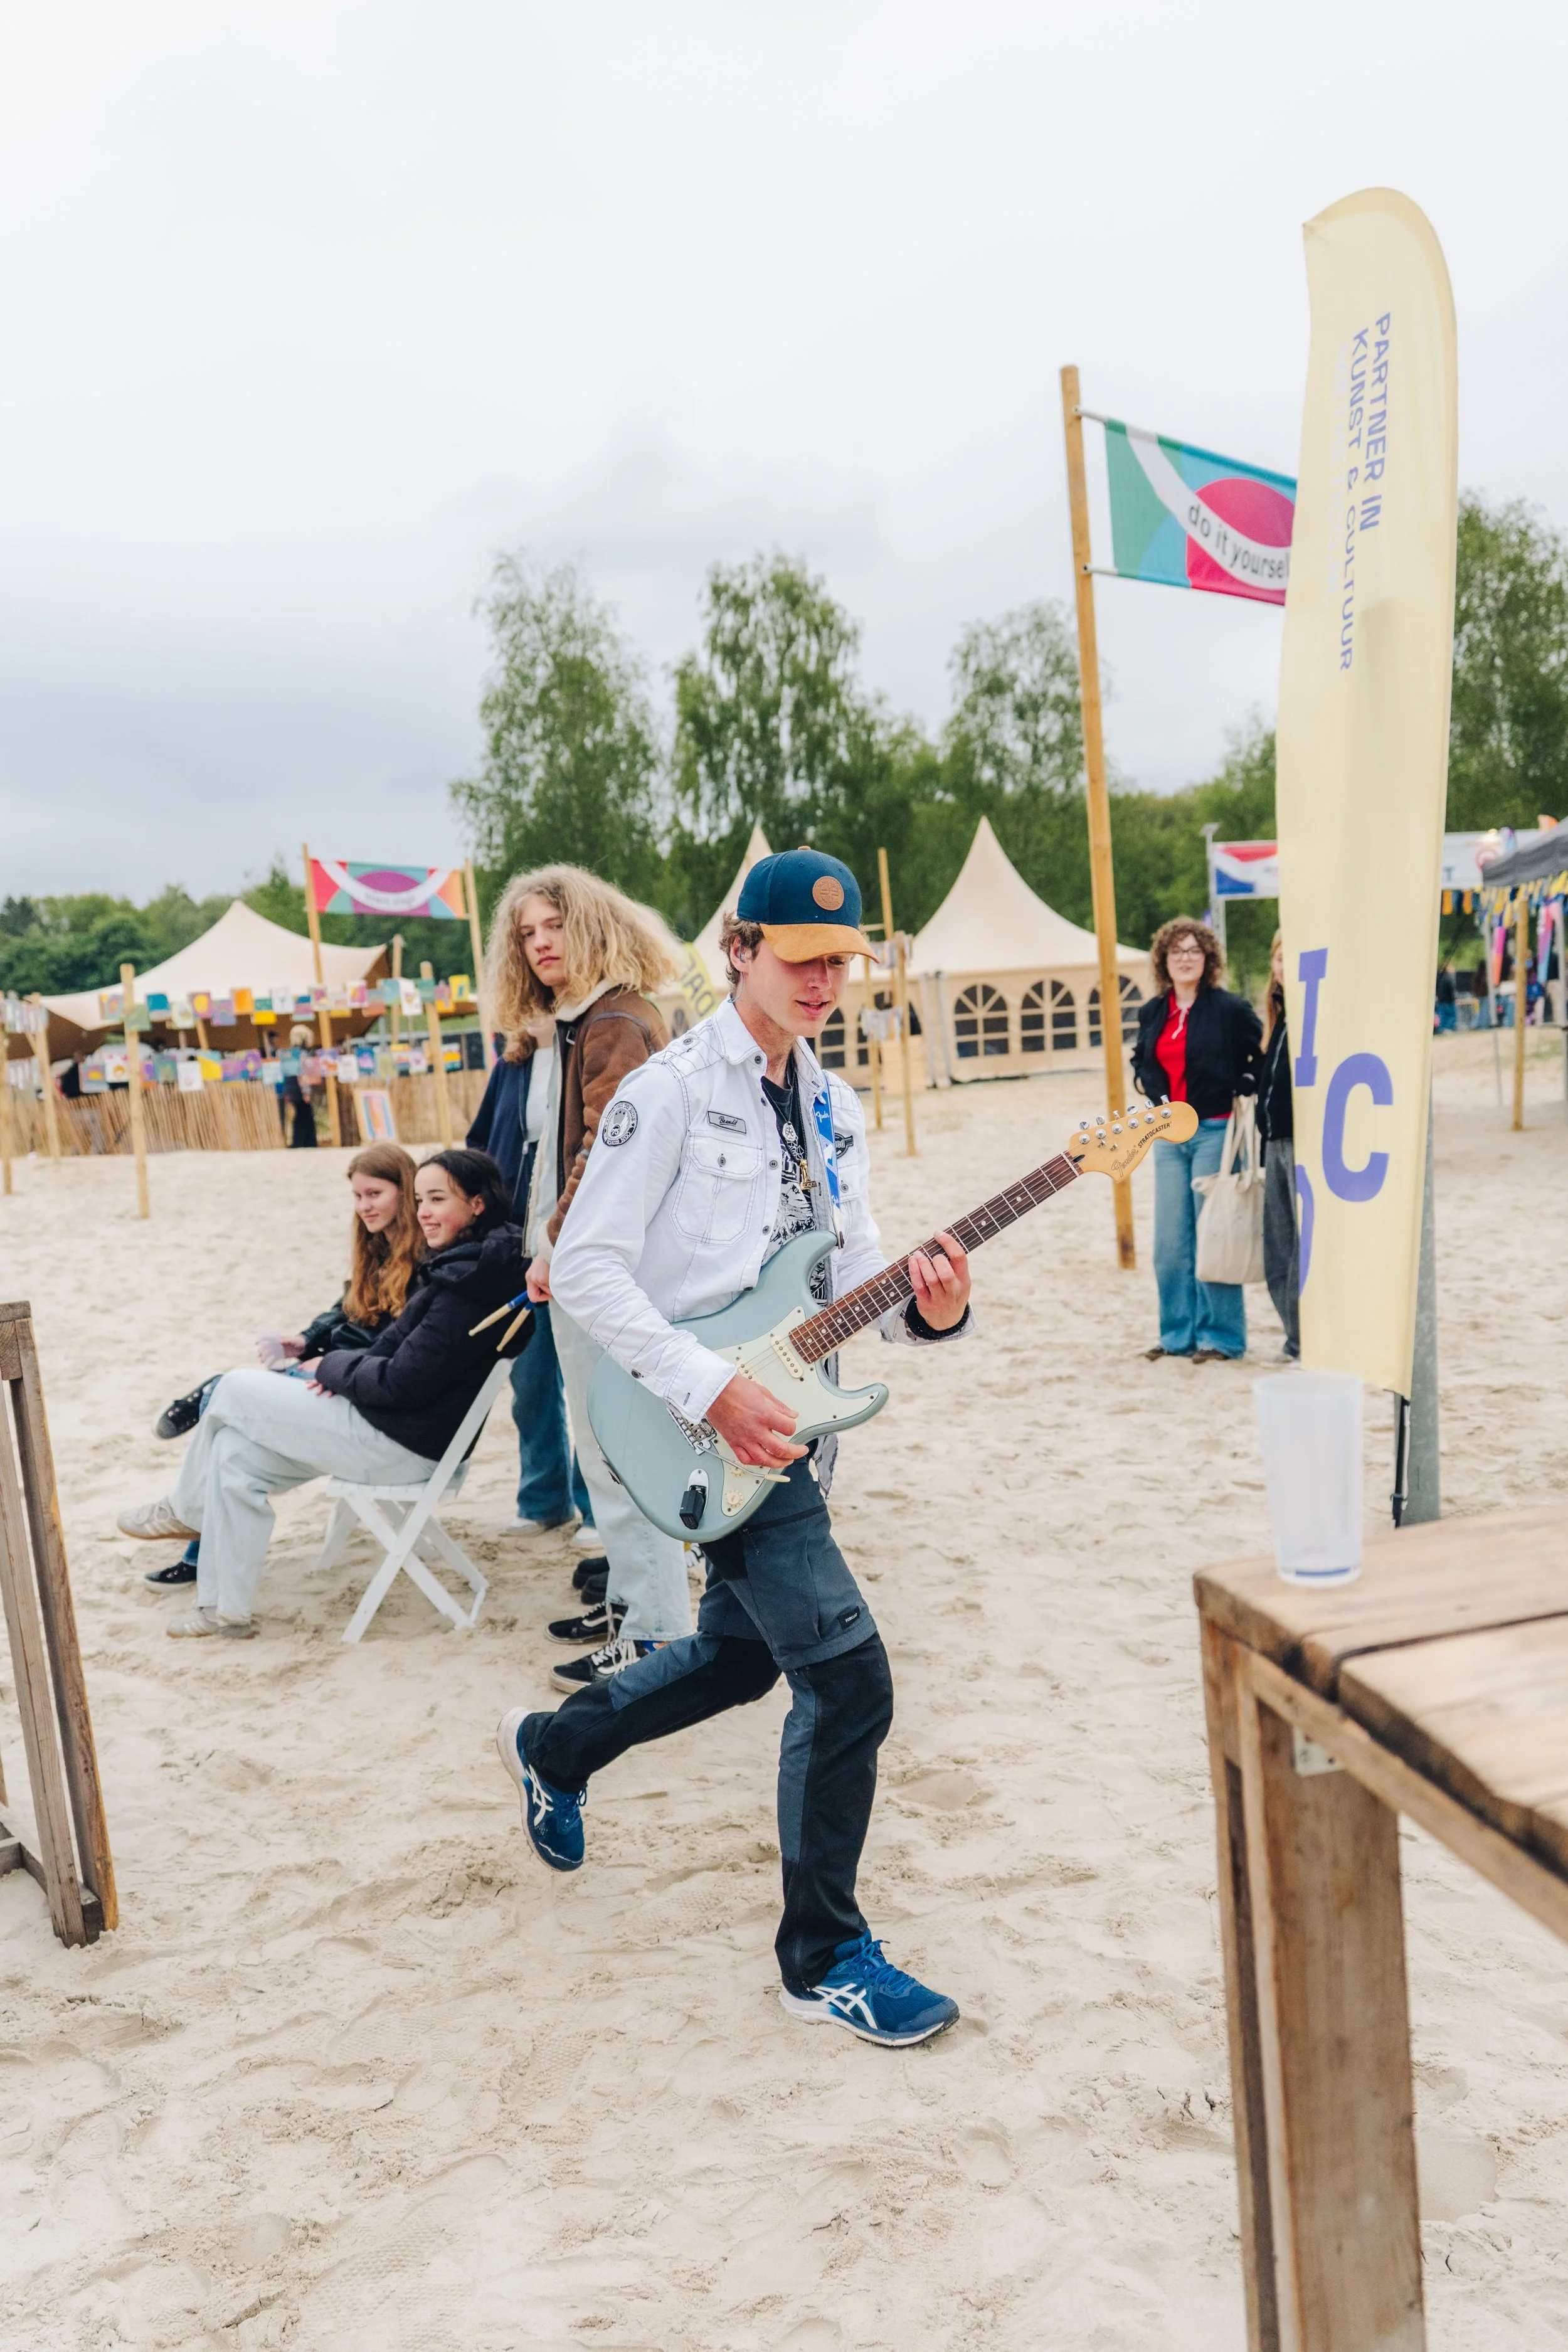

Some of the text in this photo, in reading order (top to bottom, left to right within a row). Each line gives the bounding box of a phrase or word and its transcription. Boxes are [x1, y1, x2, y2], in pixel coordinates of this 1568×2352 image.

[1359, 312, 1391, 532] PARTNER IN
[1188, 504, 1290, 578] do it yoursel
[1339, 327, 1369, 671] KUNST & CULTUUR
[1138, 1122, 1170, 1148] STRATOCASTER
